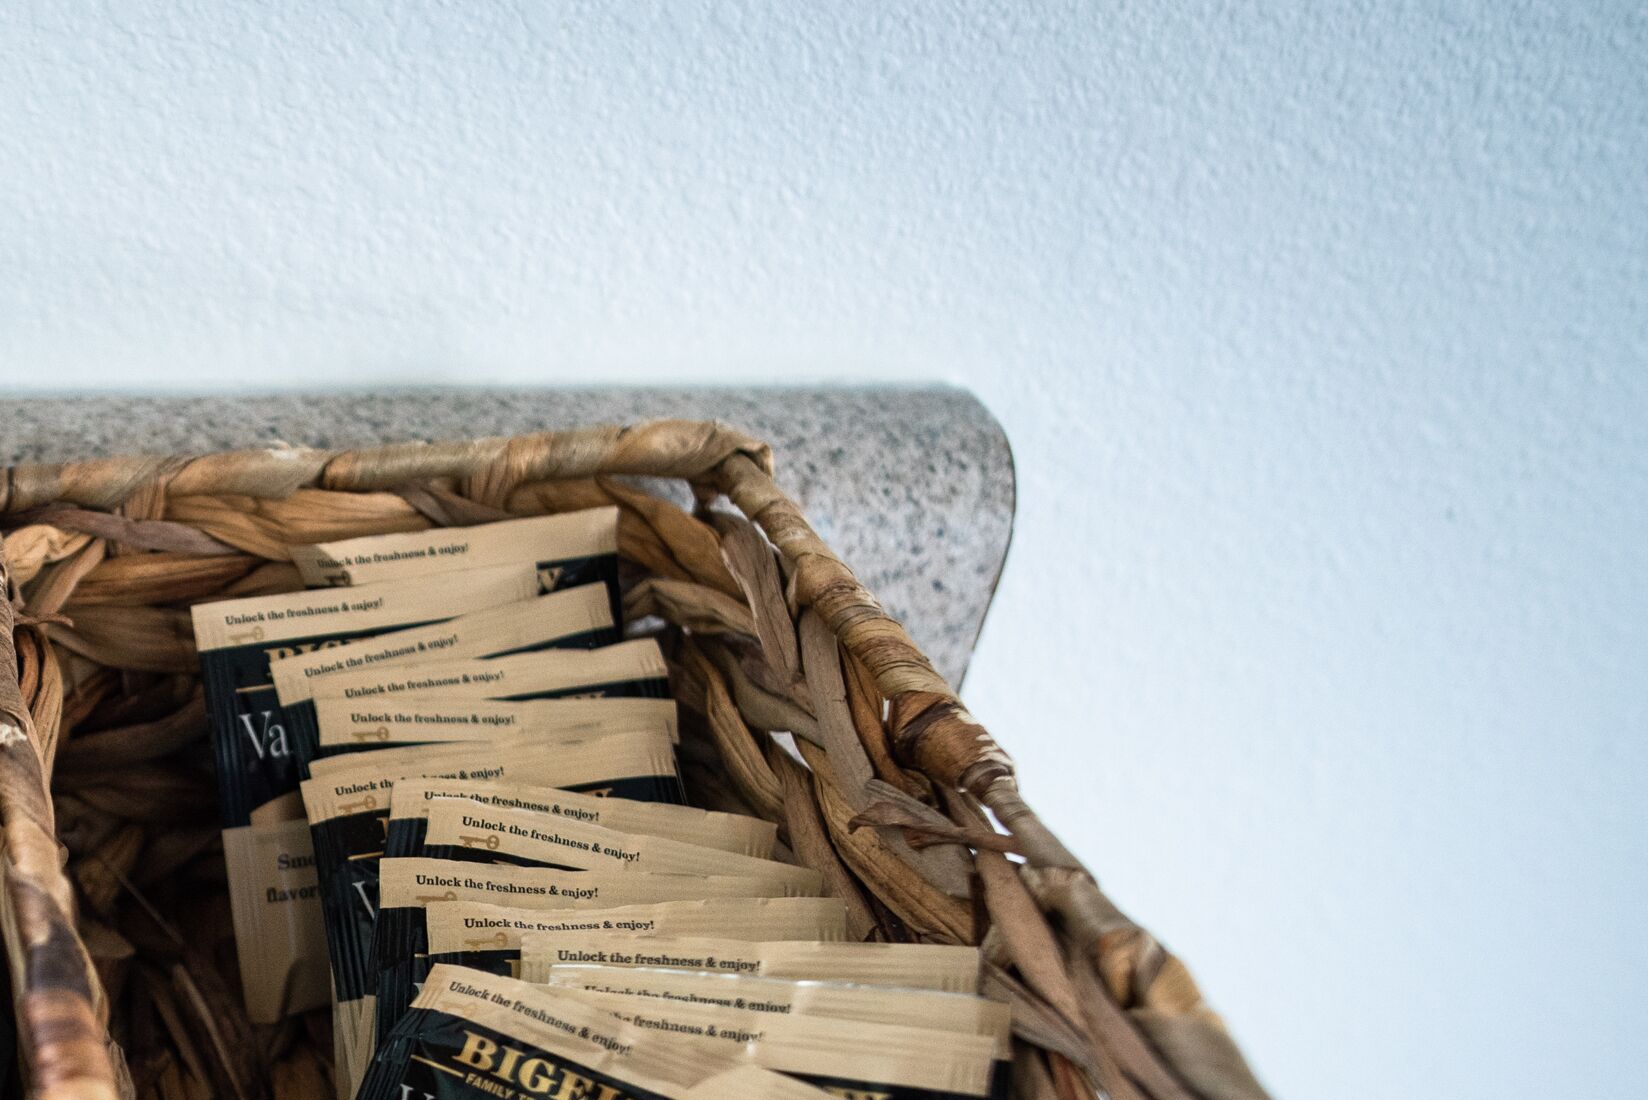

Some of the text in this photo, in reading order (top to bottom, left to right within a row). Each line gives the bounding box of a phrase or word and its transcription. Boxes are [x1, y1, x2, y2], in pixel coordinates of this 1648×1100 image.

[225, 597, 384, 626] Unlock the freshness & enjoy!
[304, 661, 345, 679] Unlock
[346, 656, 363, 668] the
[364, 646, 416, 665] freshness
[418, 641, 427, 653] &
[428, 633, 459, 651] enjoy!
[344, 670, 505, 699] Unlock the freshness & enjoy!
[351, 712, 515, 726] Unlock the freshness & enjoy!
[335, 782, 378, 798] Unlock
[380, 779, 394, 792] th
[459, 769, 468, 780] &
[470, 766, 505, 780] enjoy!
[491, 795, 550, 813] freshness
[551, 804, 562, 815] &
[563, 807, 600, 822] enjoy!
[462, 815, 641, 862] Unlock the freshness & enjoy!
[415, 874, 599, 900] Unlock the freshness & enjoy!
[464, 917, 655, 932] Unlock the freshness & enjoy!
[557, 949, 761, 973] Unlock the freshness & enjoy!
[448, 980, 633, 1058] Unlock the freshness & enjoy!
[633, 1014, 703, 1036] freshness
[705, 1025, 716, 1037] &
[719, 1028, 765, 1043] enjoy!
[464, 1073, 514, 1100] FAMILY
